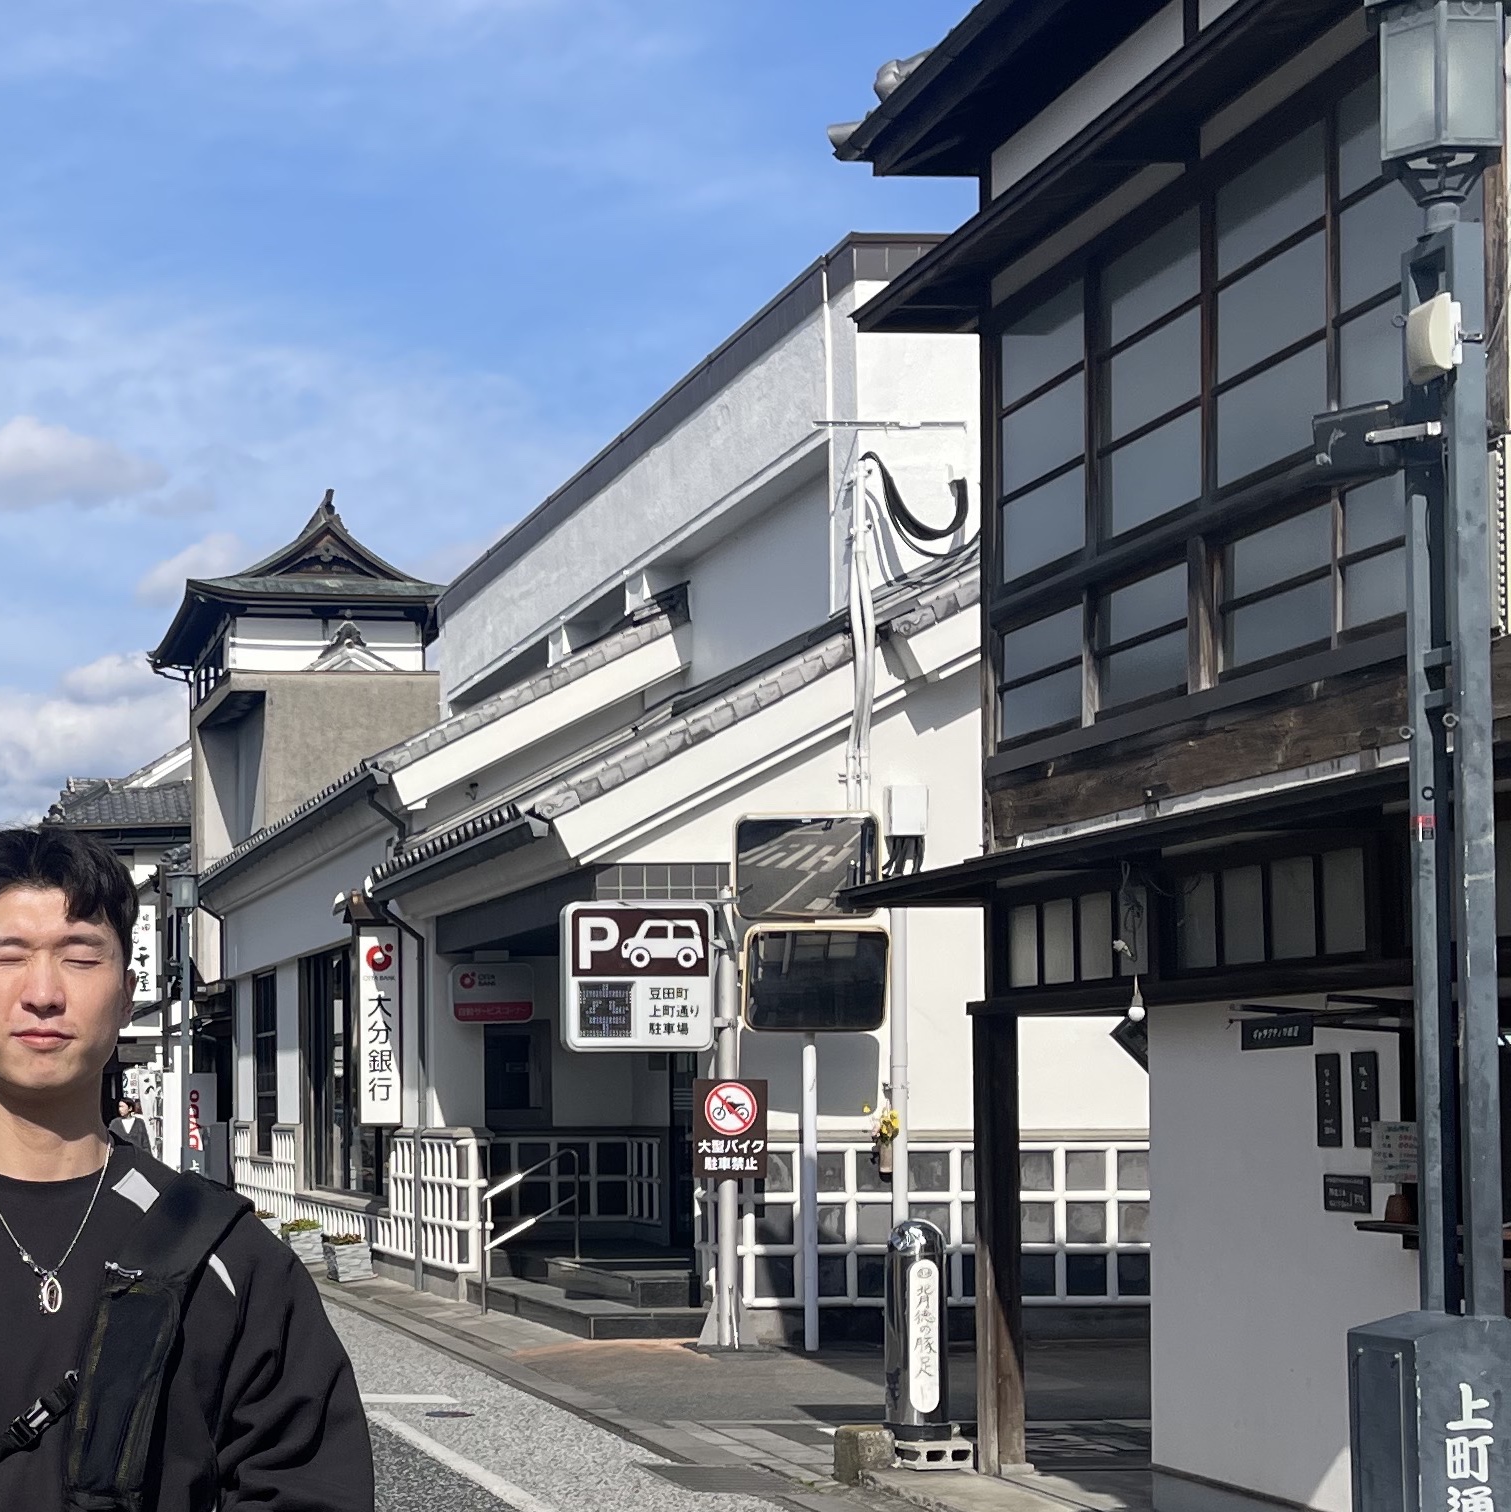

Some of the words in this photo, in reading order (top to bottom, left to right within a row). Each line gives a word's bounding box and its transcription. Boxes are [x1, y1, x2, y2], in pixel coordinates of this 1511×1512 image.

[578, 917, 619, 969] P
[649, 987, 689, 1000] 豆田町
[649, 1004, 699, 1018] 上町通り
[649, 1023, 689, 1036] 駐車場
[368, 994, 392, 1101] 大分銀行
[698, 1139, 764, 1154] 大型バイク
[704, 1157, 758, 1171] 駐車禁止
